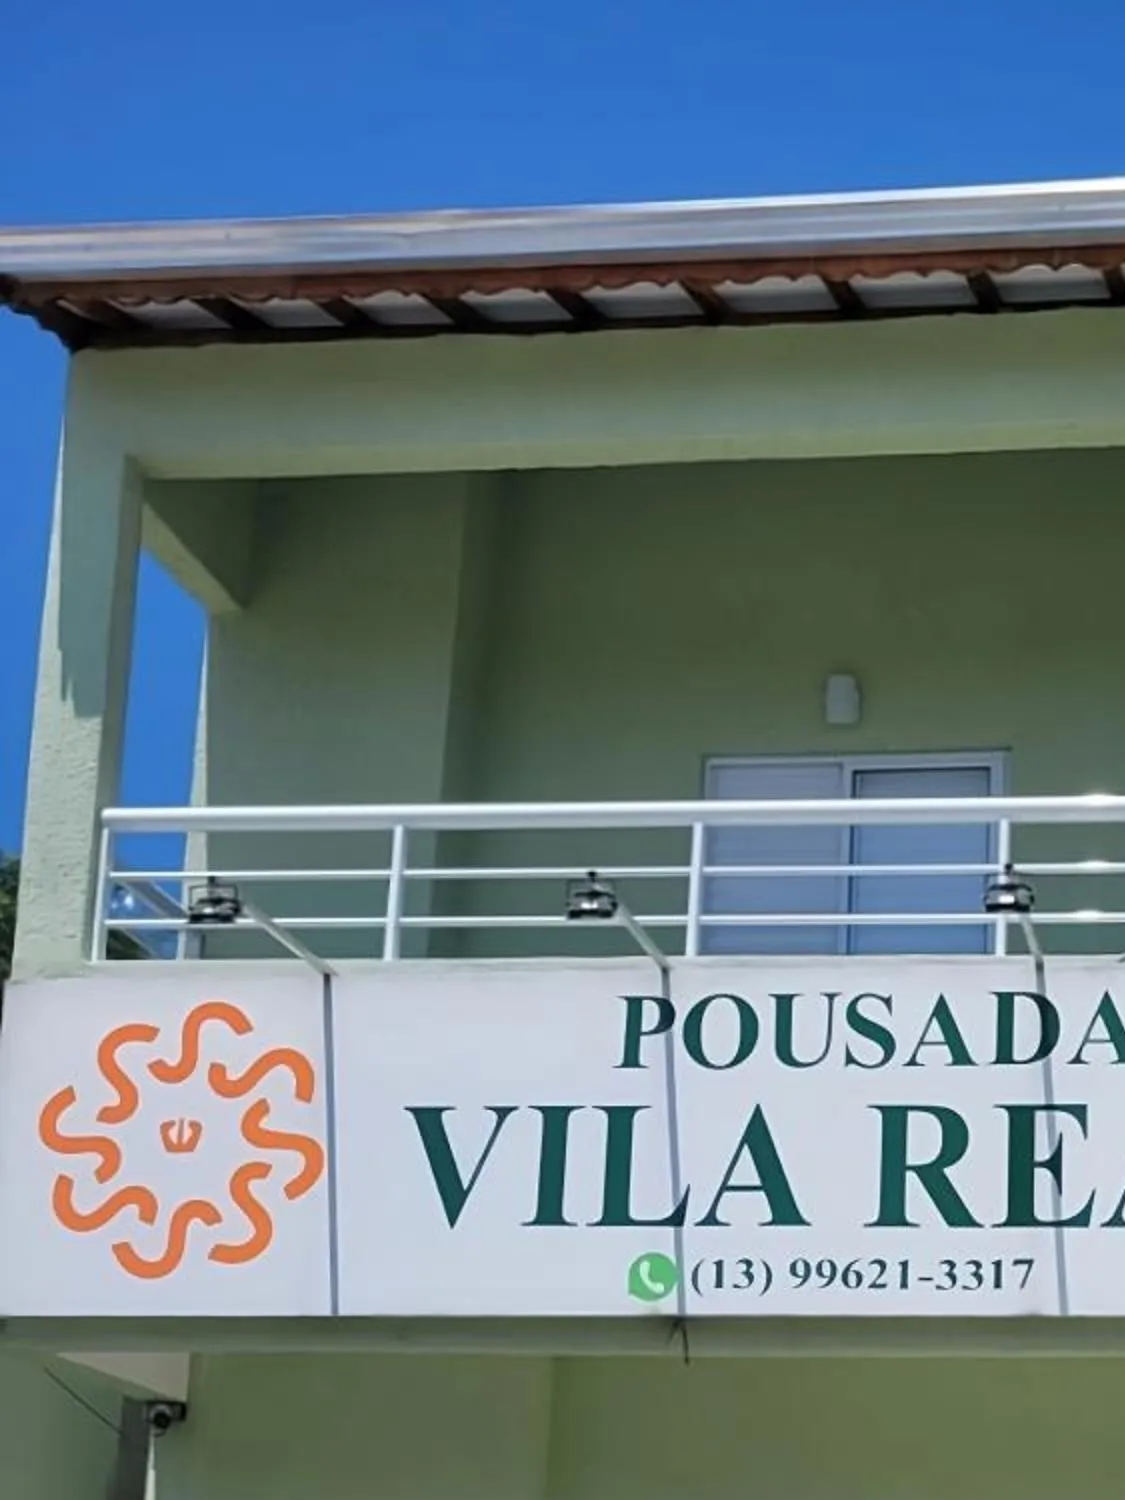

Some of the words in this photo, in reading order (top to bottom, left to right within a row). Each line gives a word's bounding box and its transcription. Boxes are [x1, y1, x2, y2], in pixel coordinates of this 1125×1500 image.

[403, 1102, 812, 1230] VILA
[690, 1257, 774, 1295] (13)
[788, 1257, 1035, 1292] 99621-3317
